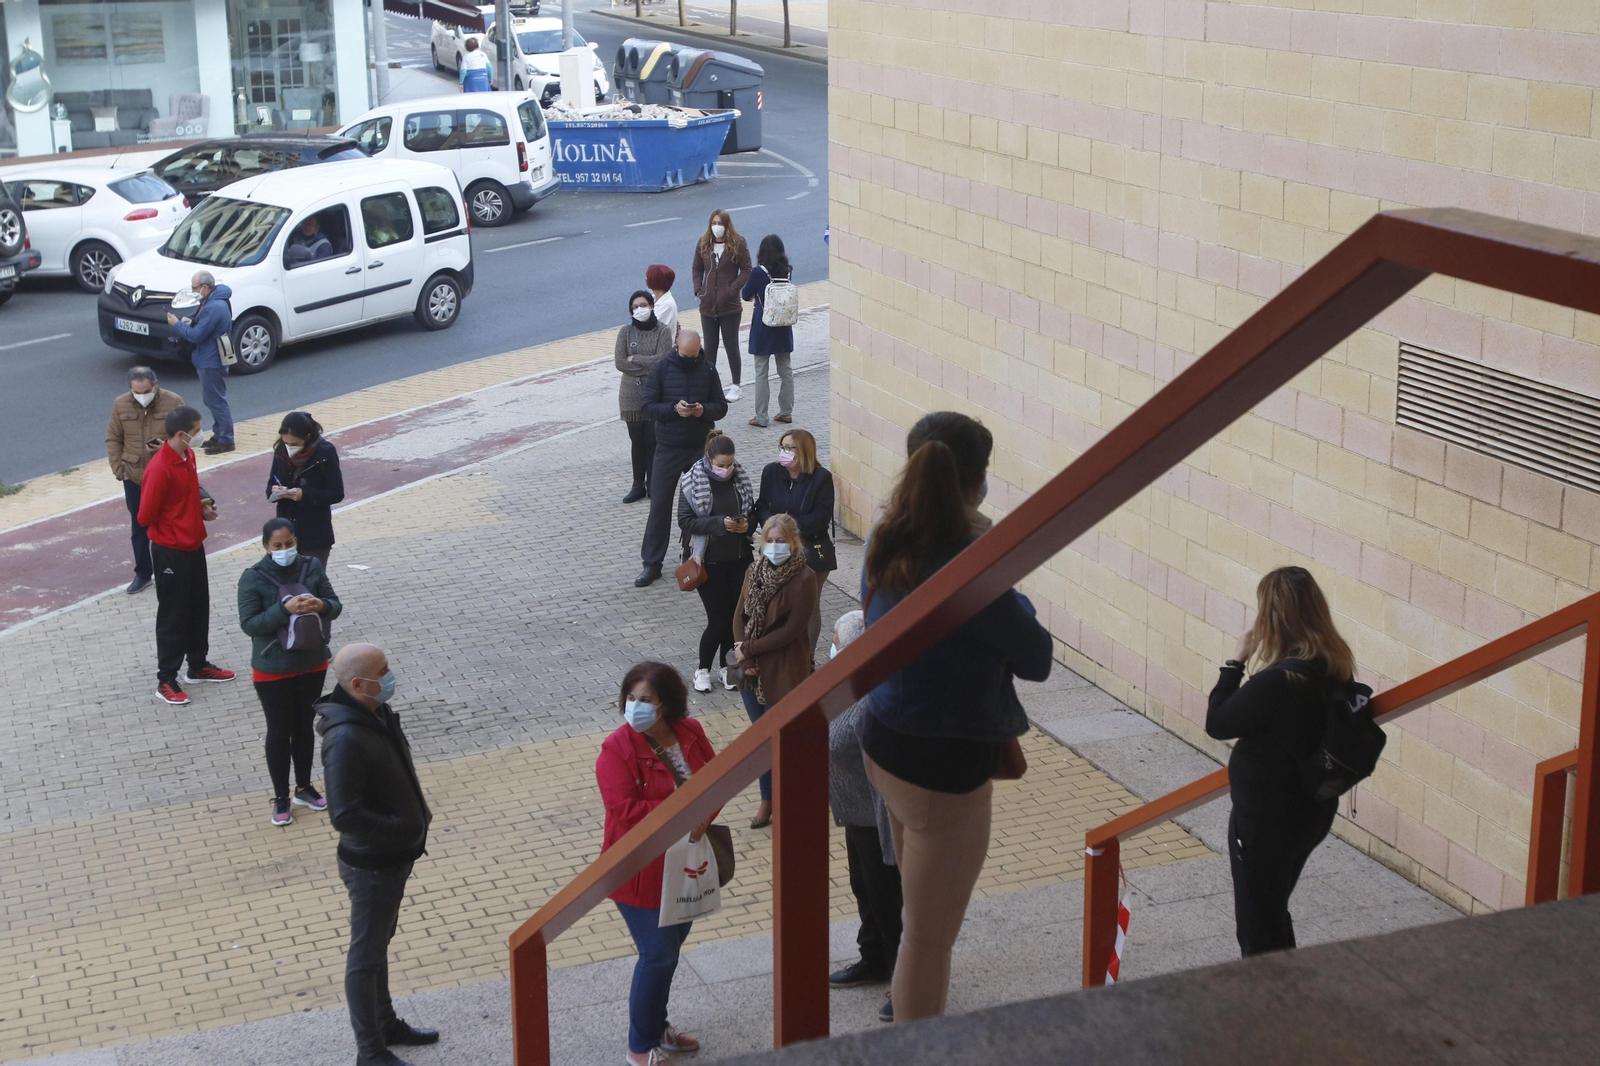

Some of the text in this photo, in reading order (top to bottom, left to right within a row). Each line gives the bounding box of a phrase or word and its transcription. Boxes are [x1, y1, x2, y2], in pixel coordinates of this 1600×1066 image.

[575, 172, 589, 183] 957
[591, 172, 601, 183] 32
[602, 172, 611, 183] 01
[612, 172, 623, 183] 64
